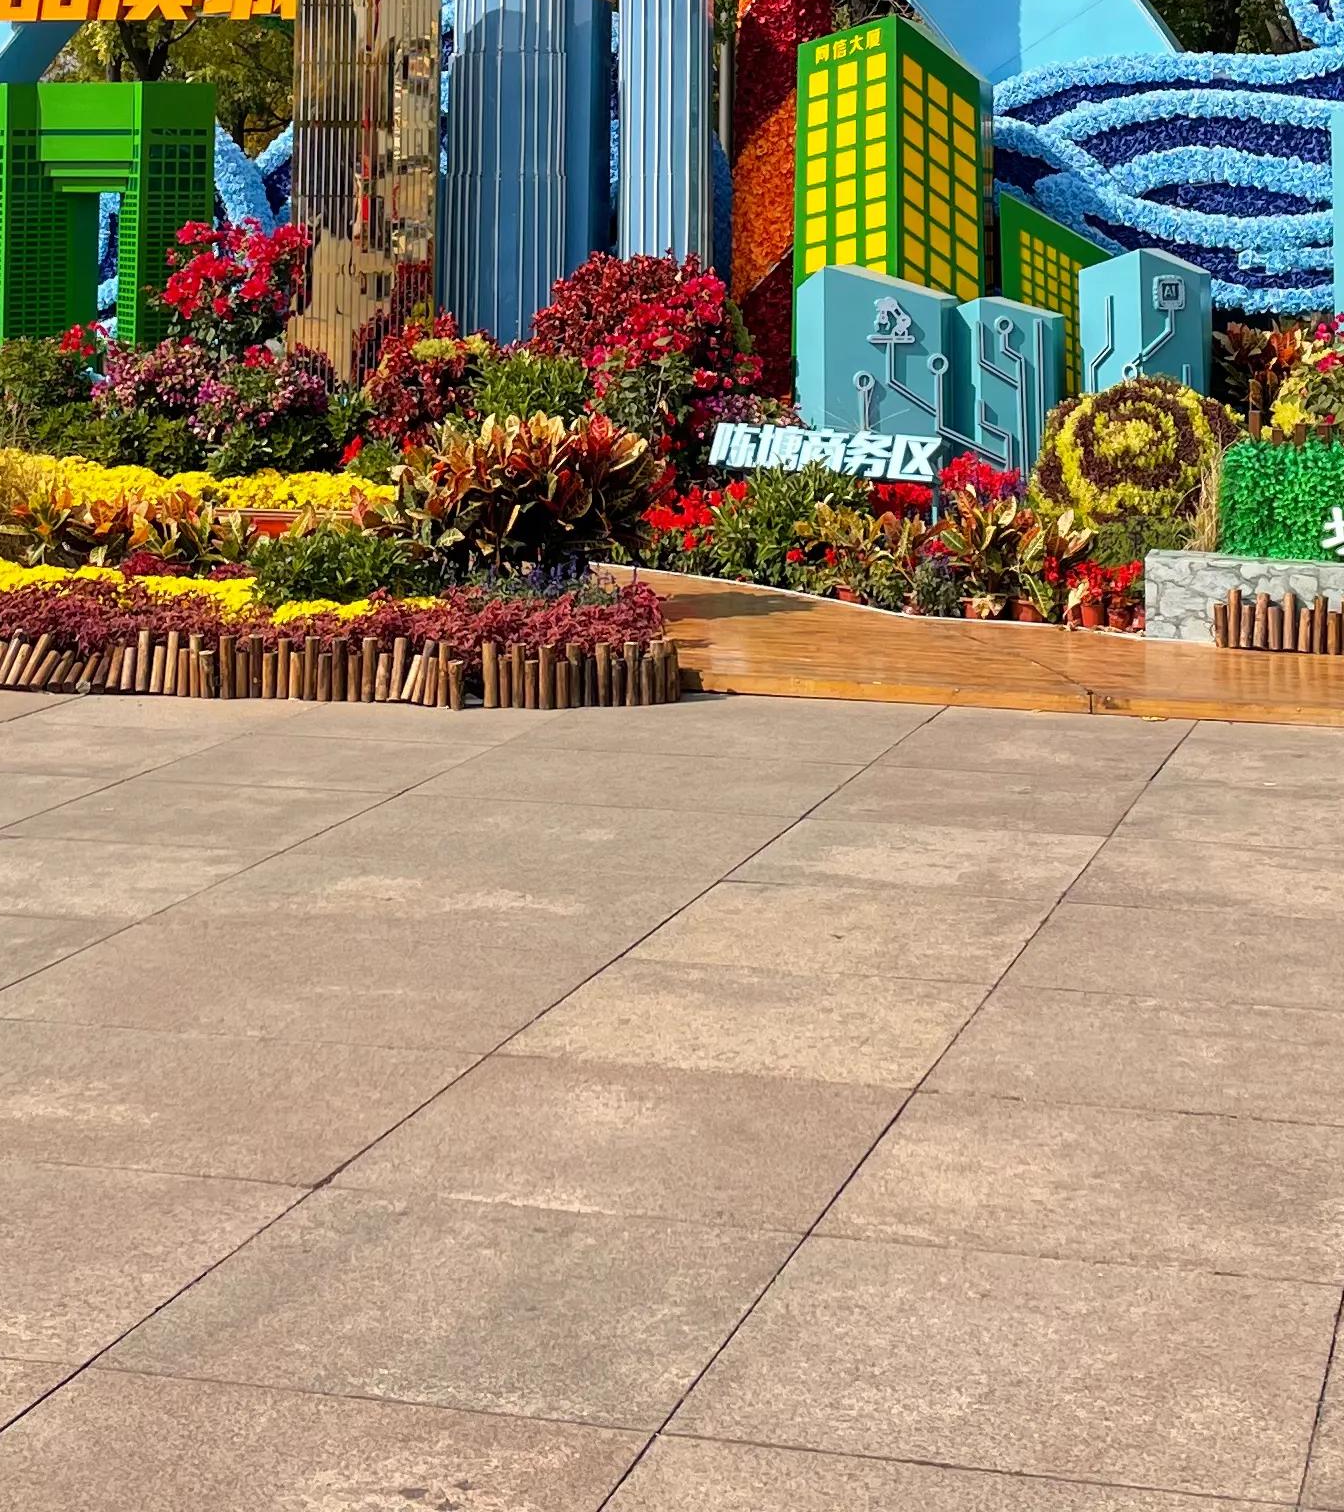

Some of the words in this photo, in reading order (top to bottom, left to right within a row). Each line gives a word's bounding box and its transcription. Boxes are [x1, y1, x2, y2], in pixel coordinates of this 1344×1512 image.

[1164, 285, 1176, 297] AI
[708, 422, 942, 482] 陈塘商务区
